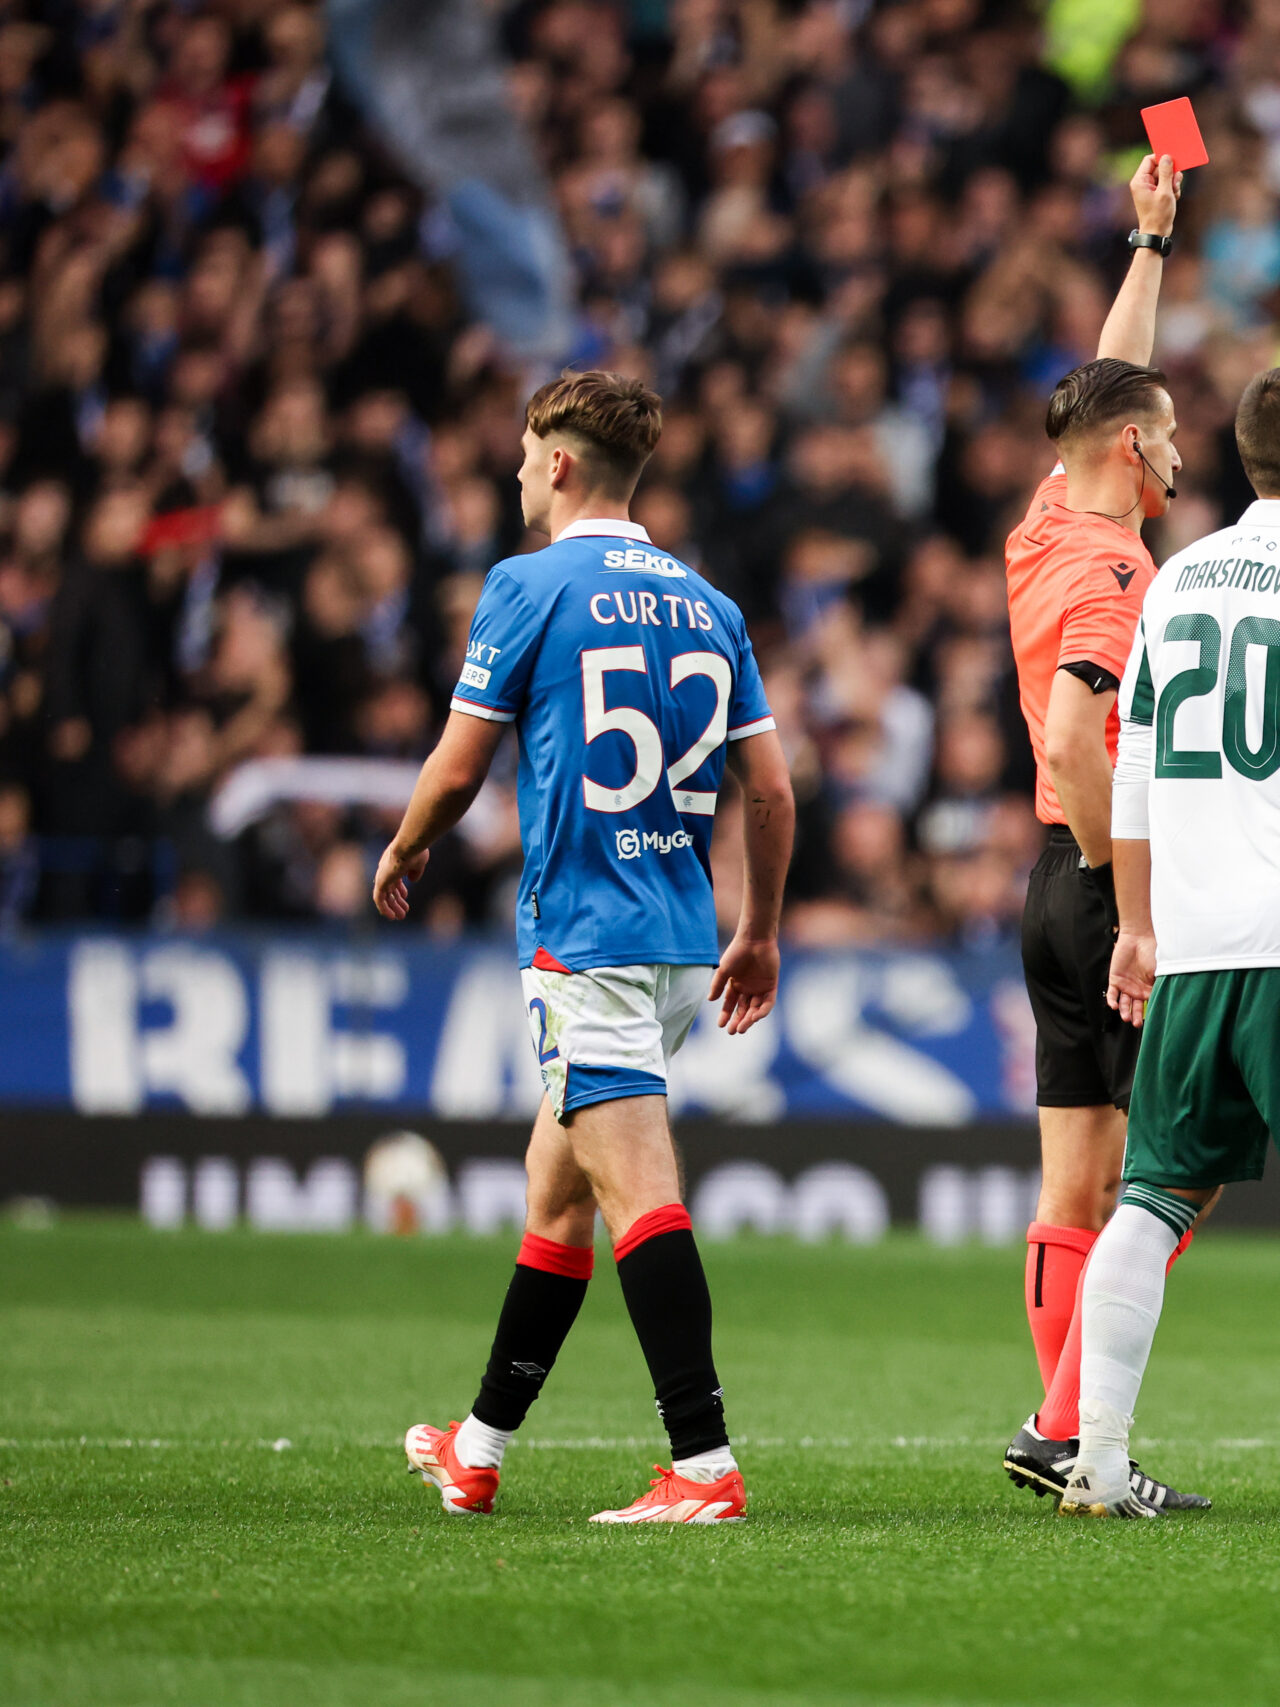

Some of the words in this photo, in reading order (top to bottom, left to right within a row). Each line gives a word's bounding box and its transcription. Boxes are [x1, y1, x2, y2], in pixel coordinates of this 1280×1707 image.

[603, 549, 687, 577] SEKO
[590, 591, 713, 631] CURTIS
[581, 645, 732, 816] 52
